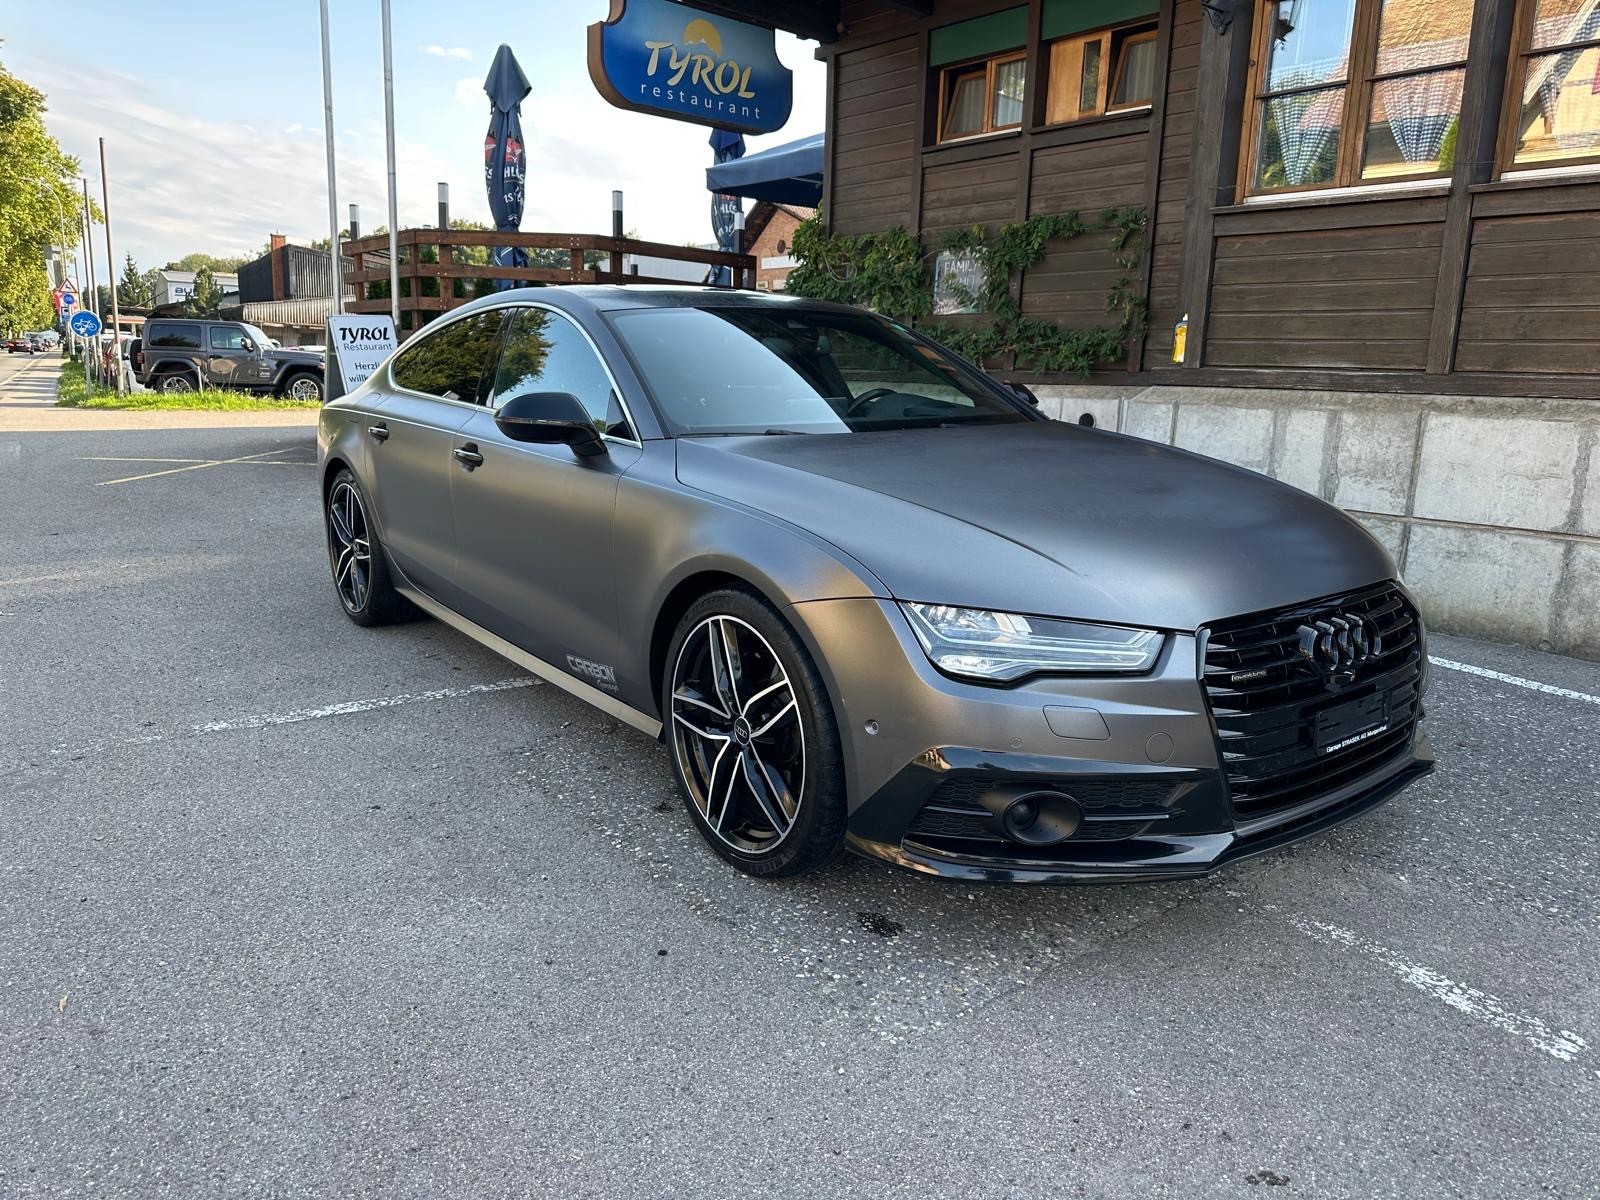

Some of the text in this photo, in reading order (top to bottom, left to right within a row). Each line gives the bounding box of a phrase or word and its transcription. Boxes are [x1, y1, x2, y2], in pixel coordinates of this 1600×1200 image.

[645, 41, 756, 99] TYROL
[640, 83, 760, 119] restaurant
[339, 327, 390, 344] TYROL
[343, 343, 393, 351] Restaurant
[566, 655, 616, 681] CARBON
